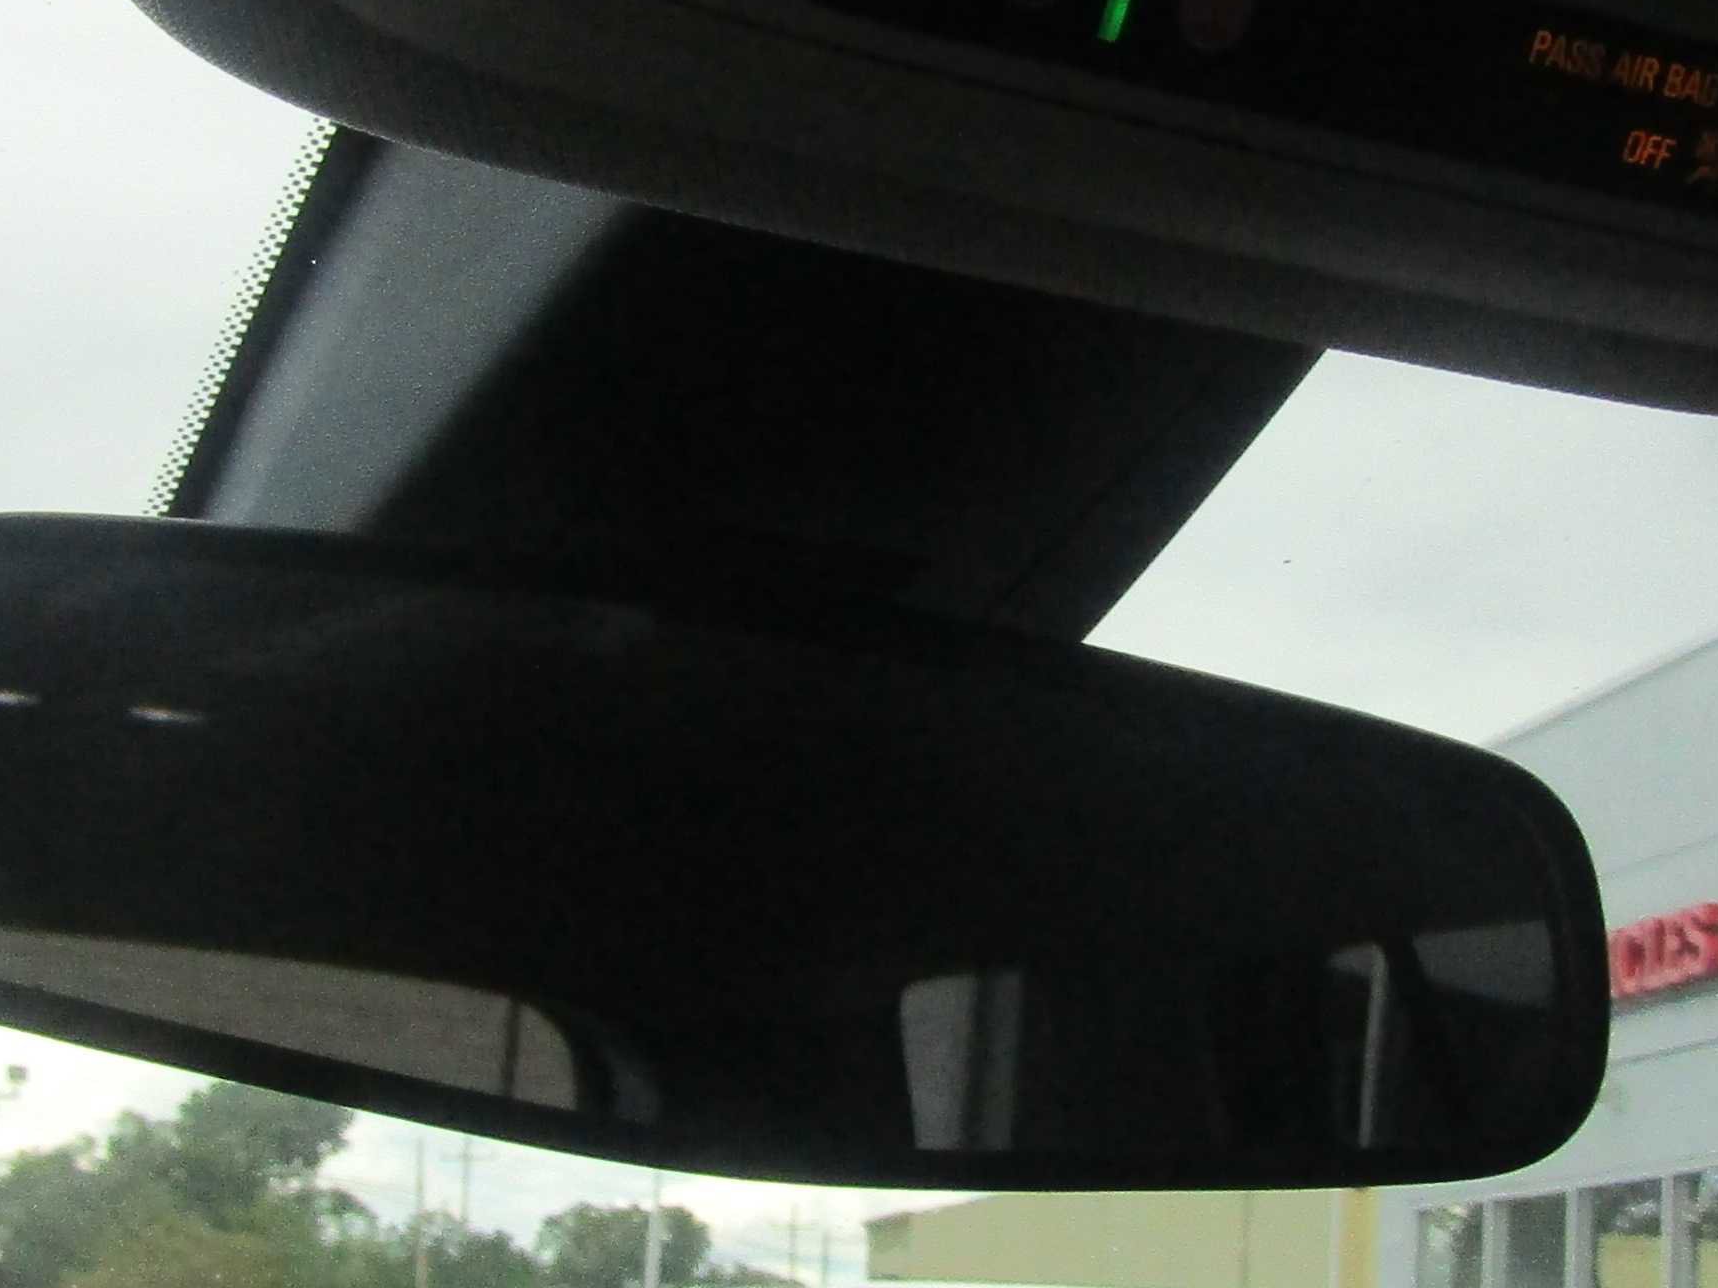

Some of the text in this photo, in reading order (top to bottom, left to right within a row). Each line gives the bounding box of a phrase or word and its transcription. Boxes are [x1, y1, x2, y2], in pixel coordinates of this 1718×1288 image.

[1529, 28, 1607, 80] PASS
[1613, 51, 1660, 92] AIR
[1624, 129, 1678, 169] OFF
